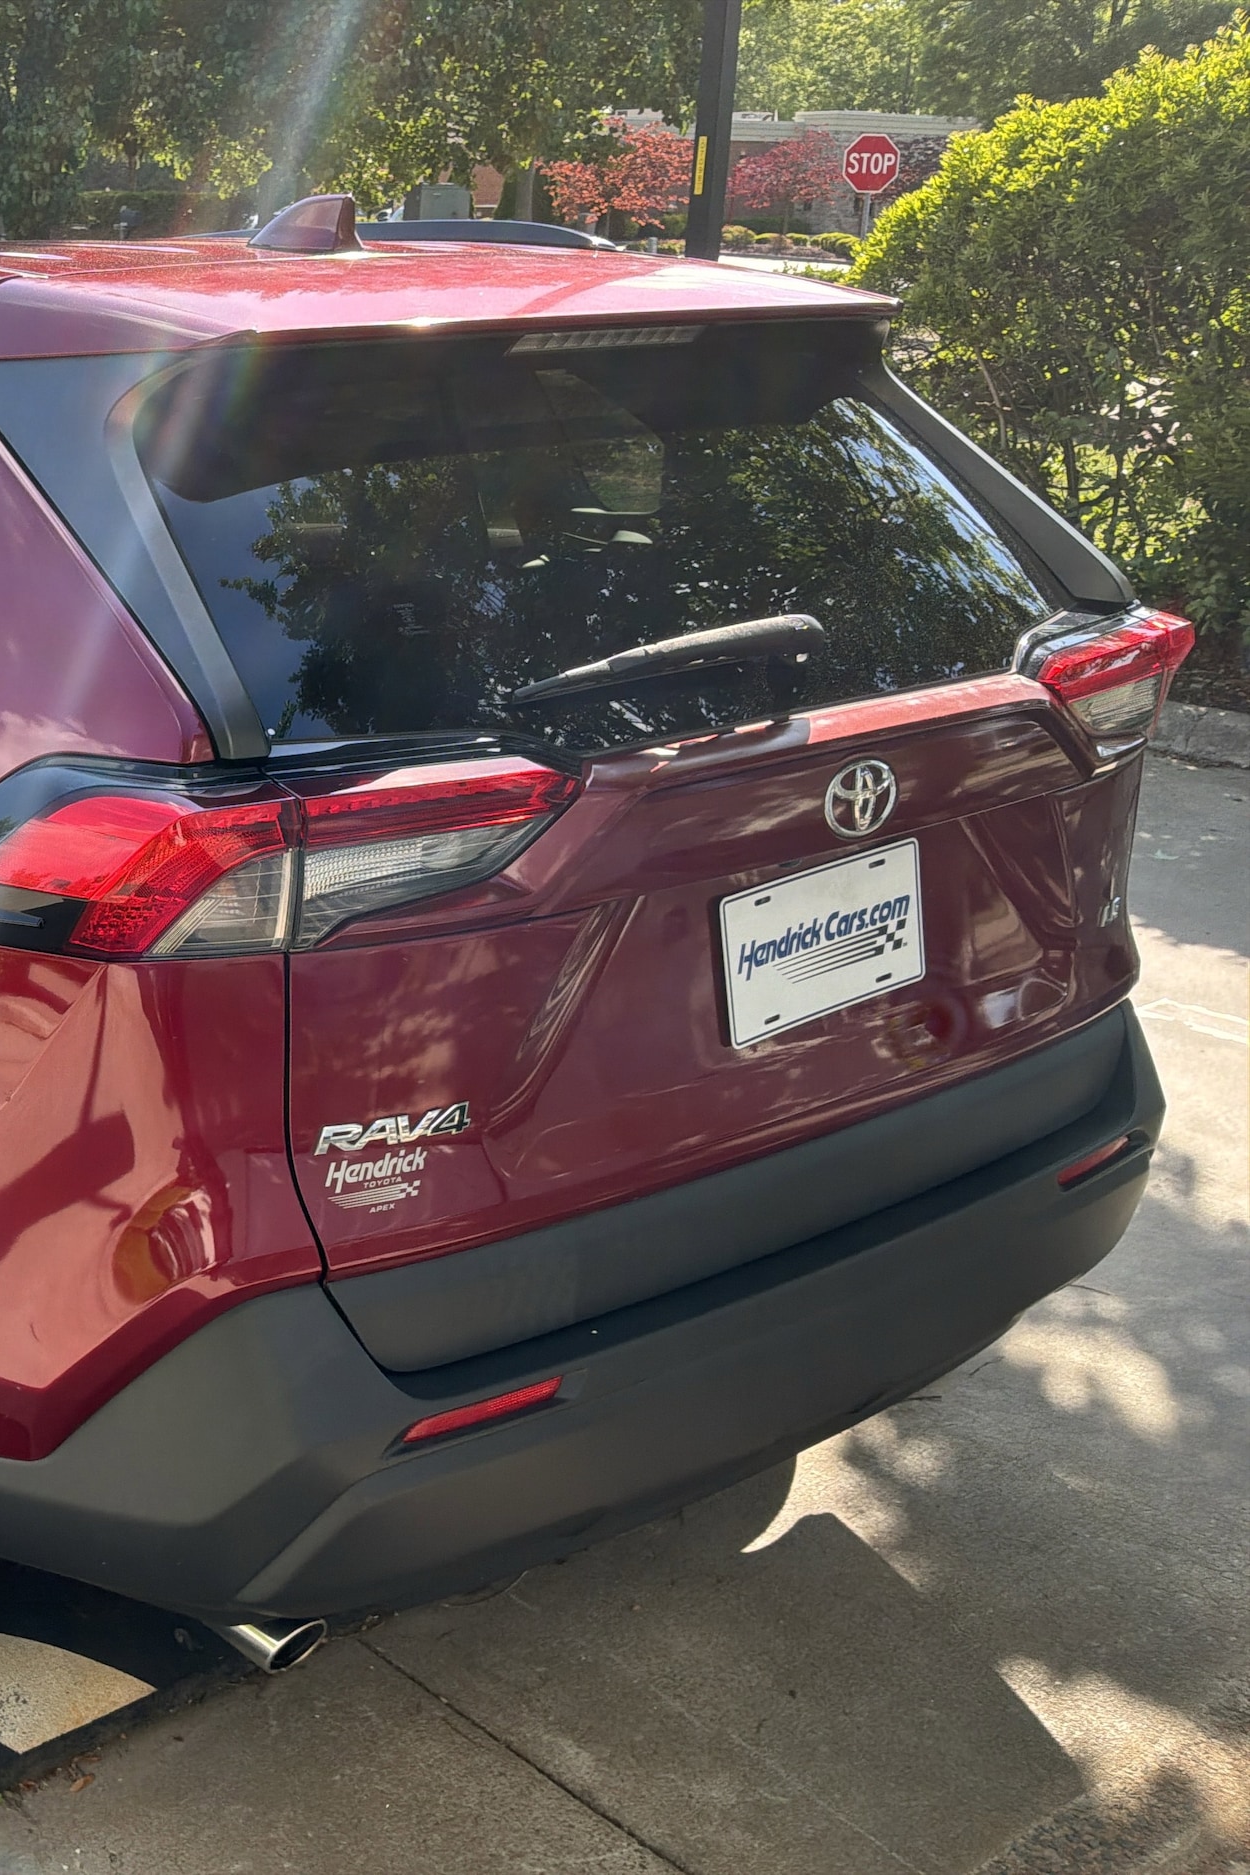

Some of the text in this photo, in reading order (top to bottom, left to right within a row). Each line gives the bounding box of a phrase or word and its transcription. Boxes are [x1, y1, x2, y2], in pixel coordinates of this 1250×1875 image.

[847, 152, 896, 175] STOP
[314, 1101, 471, 1156] RAV4
[324, 1146, 428, 1194] Hendrick
[363, 1176, 403, 1189] TOYOTA
[369, 1203, 396, 1214] APEX
